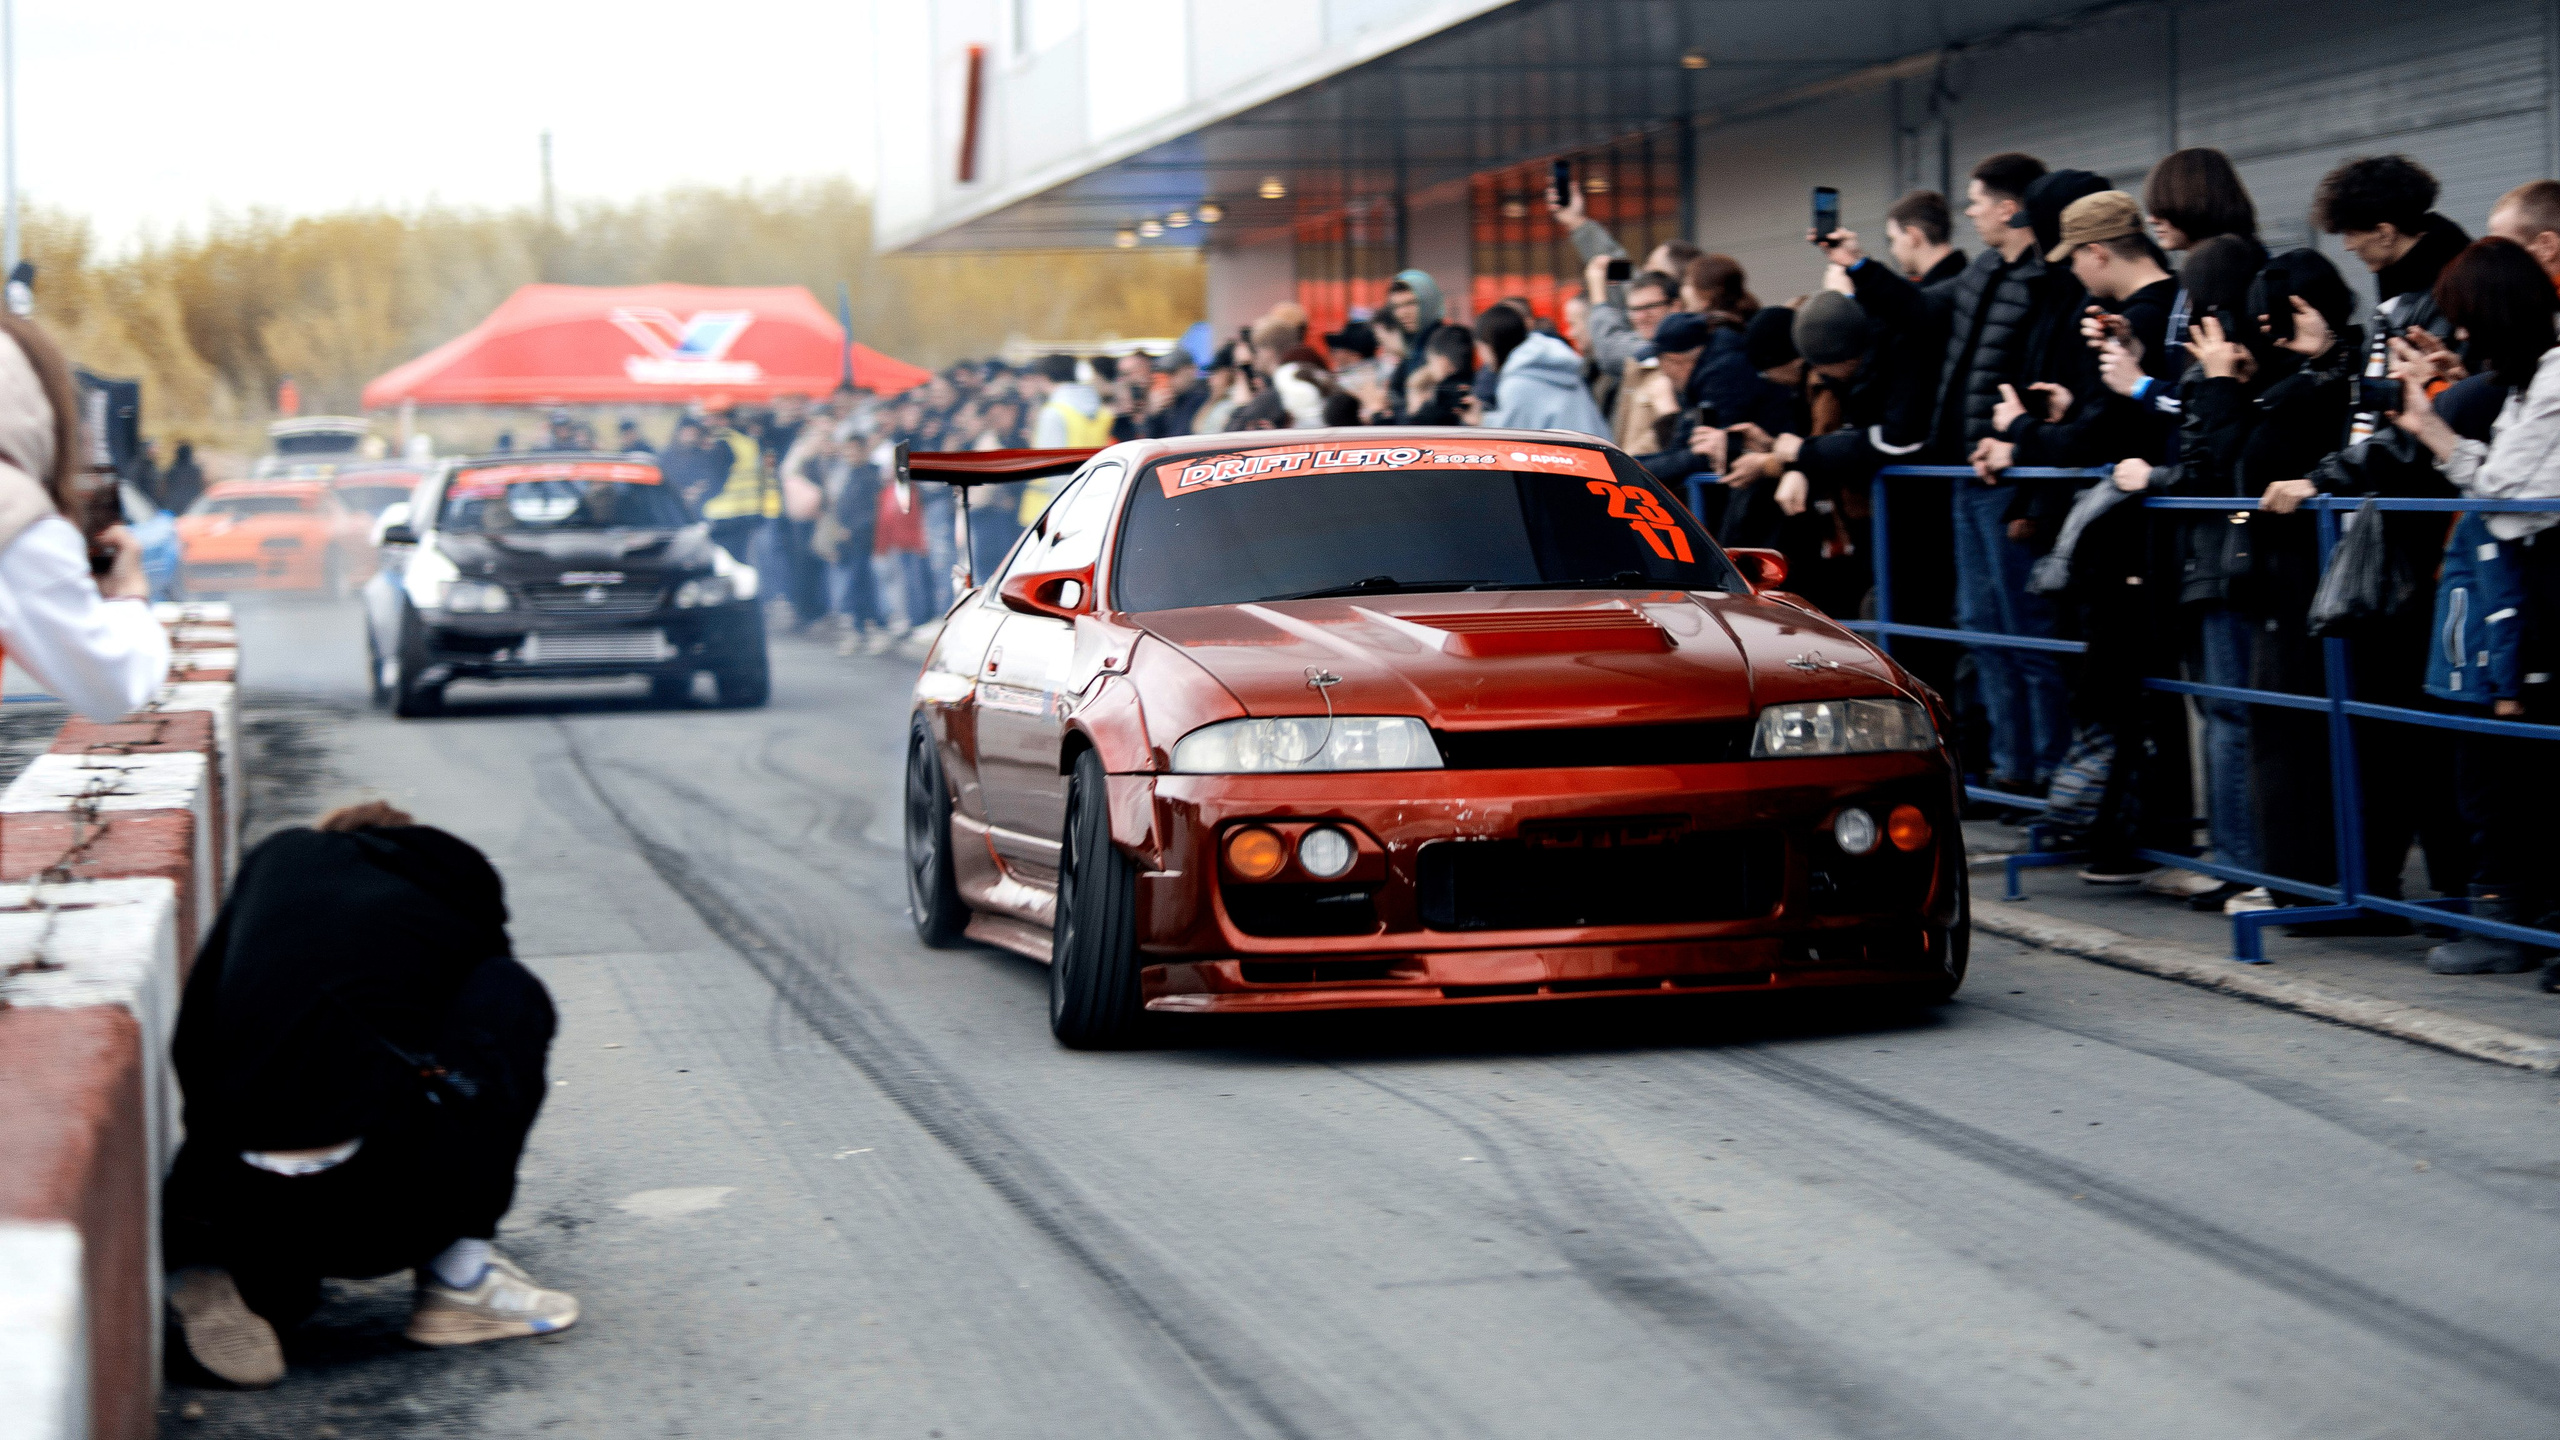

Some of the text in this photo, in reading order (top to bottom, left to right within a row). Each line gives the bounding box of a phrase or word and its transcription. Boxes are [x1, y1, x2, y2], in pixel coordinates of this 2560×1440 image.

[1179, 447, 1496, 487] DRIFT LETO 2026
[1585, 480, 1675, 525] 23
[1628, 519, 1695, 564] 17
